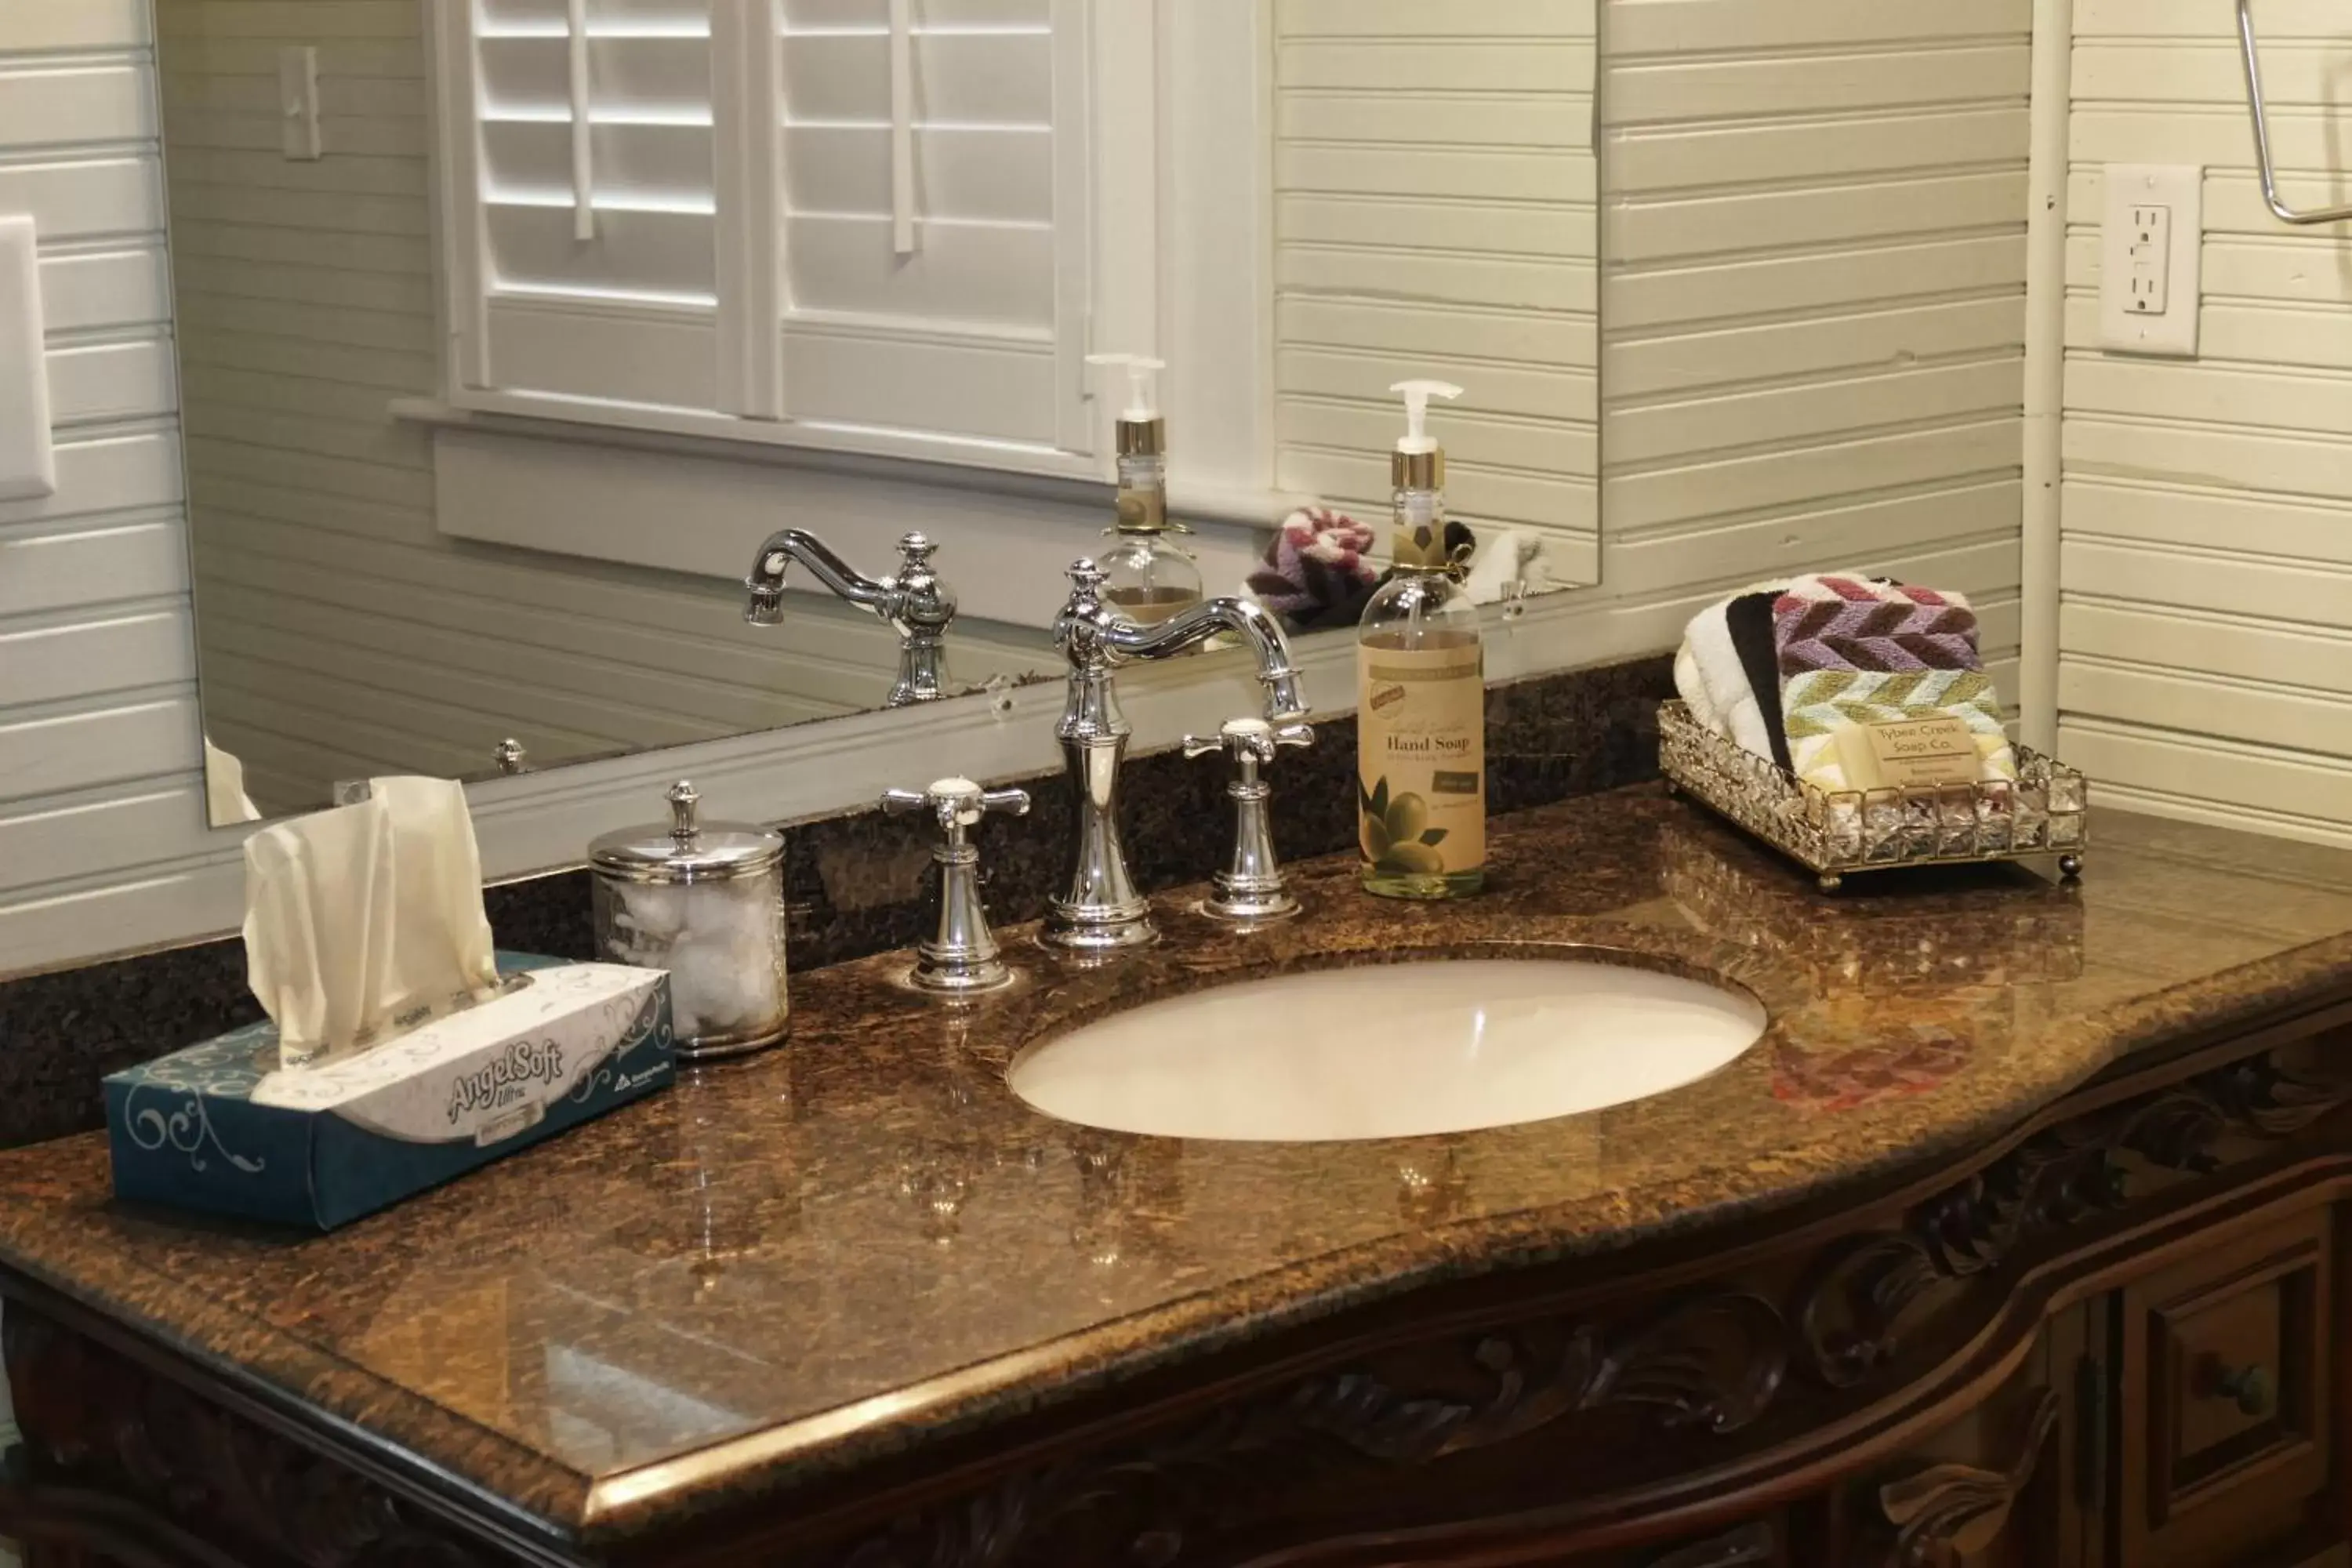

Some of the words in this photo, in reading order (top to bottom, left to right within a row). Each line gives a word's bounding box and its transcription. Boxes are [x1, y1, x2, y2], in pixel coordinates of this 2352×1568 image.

[1388, 735, 1429, 751] Hand
[1436, 736, 1470, 753] Soap
[1893, 740, 1927, 753] Soap
